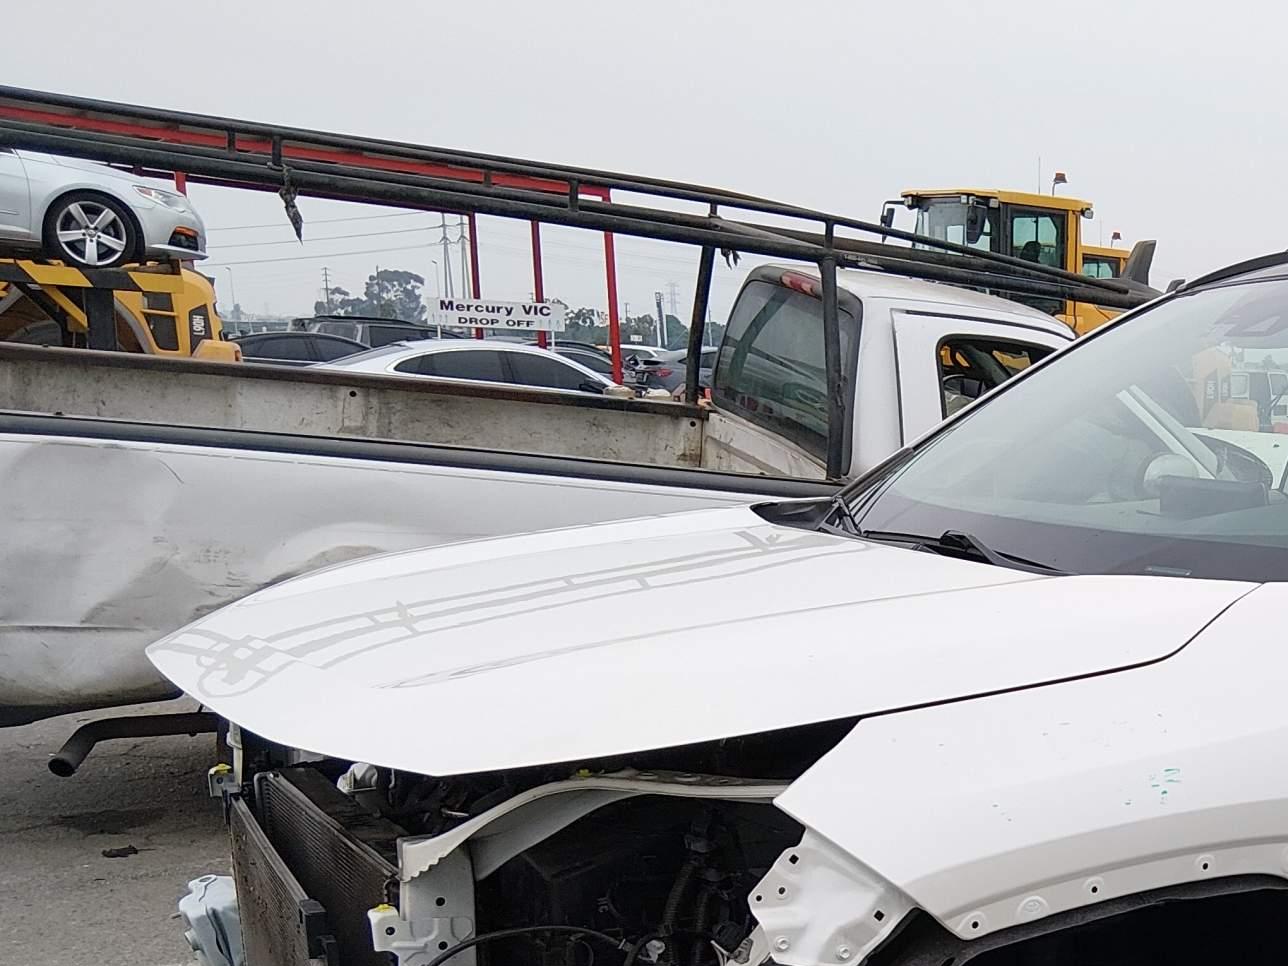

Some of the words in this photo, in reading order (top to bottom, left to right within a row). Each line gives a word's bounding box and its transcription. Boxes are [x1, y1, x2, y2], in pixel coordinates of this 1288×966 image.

[440, 300, 514, 316] Mercury
[521, 304, 551, 316] VIC
[457, 316, 500, 326] DROP
[505, 319, 535, 328] OFF
